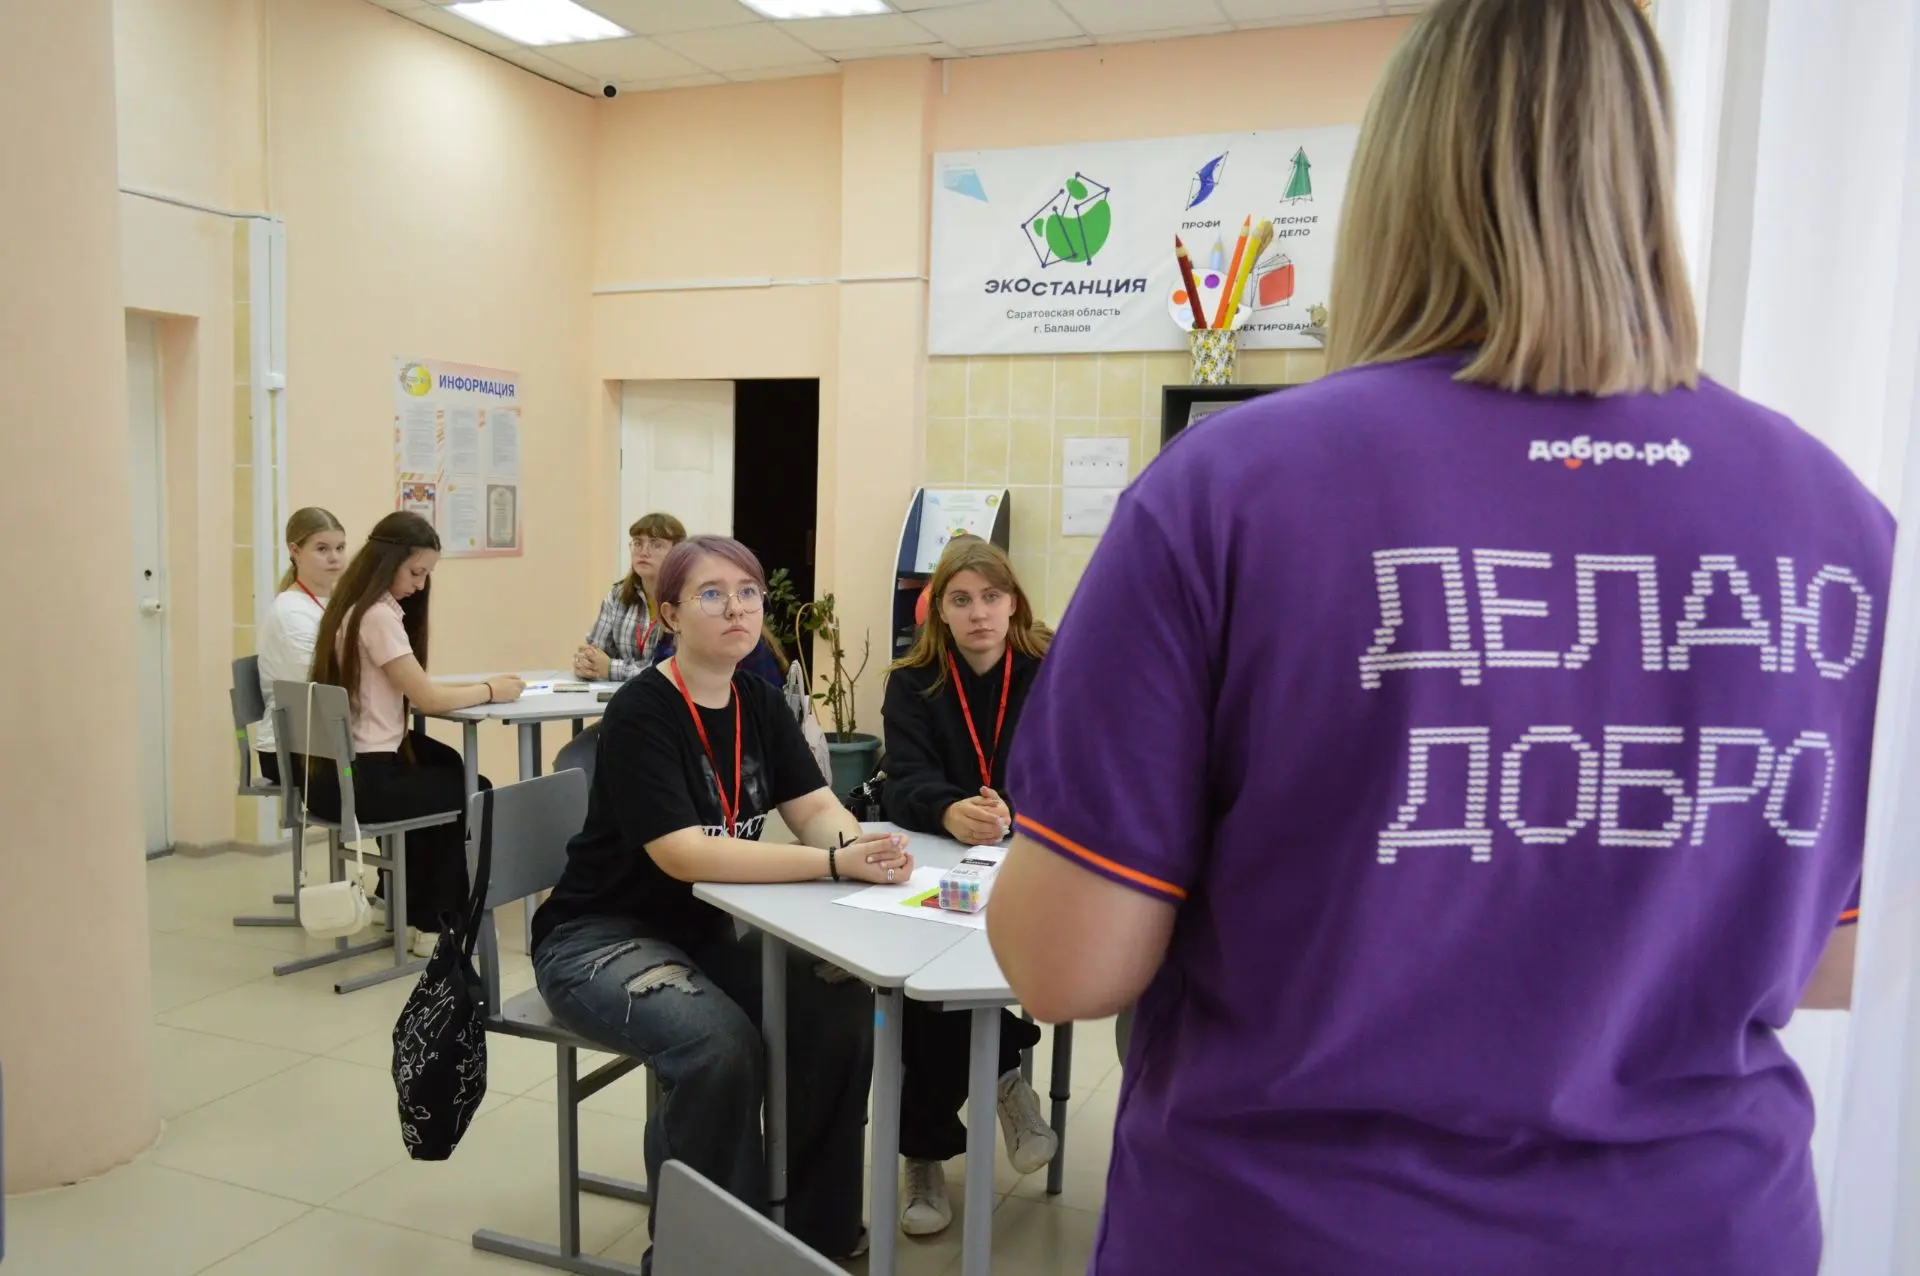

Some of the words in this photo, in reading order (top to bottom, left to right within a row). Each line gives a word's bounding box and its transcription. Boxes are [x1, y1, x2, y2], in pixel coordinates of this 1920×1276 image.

[1182, 220, 1221, 229] ПРОФИ
[1272, 216, 1319, 225] ЛЕСНОЕ
[1278, 229, 1311, 238] ДЕЛО
[984, 278, 1147, 297] ЭКОСТАНЦИЯ
[1006, 308, 1074, 320] Саратовская
[1077, 307, 1121, 318] область
[1044, 324, 1091, 333] Балашов
[439, 374, 515, 398] ИНФОРМАЦИЯ
[1528, 436, 1691, 468] добро.рф
[1359, 547, 1874, 689] ДЕЛАЮ
[1377, 726, 1835, 864] ДОБРО
